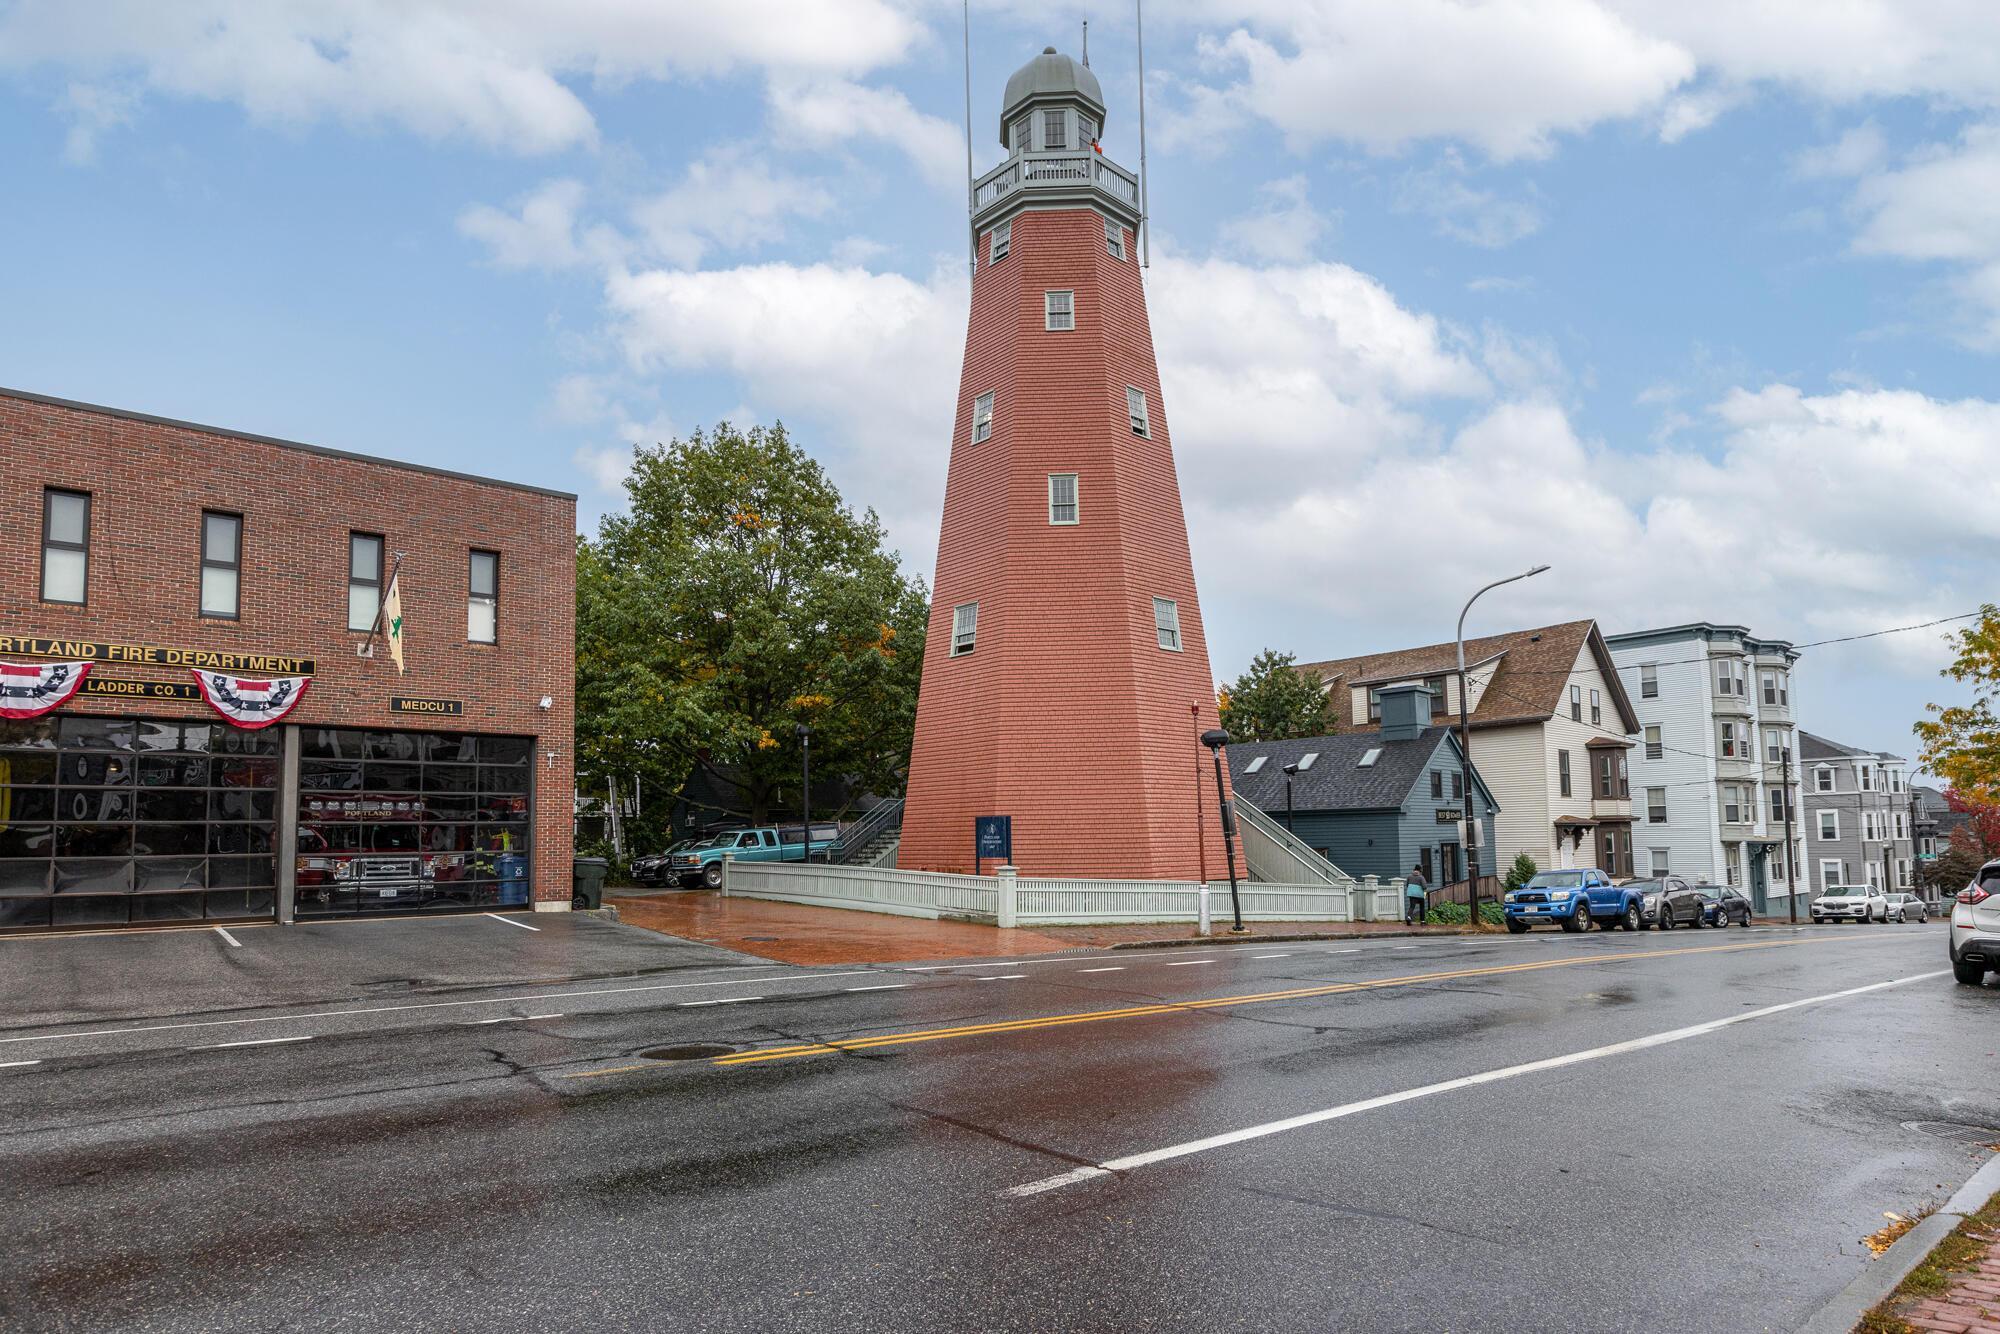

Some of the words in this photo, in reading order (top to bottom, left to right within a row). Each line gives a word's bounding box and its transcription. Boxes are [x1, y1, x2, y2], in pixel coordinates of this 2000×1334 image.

[108, 646, 157, 662] FIRE
[167, 650, 305, 673] DEPARTMENT
[87, 680, 145, 694] LADDER
[154, 684, 177, 696] CO.
[183, 686, 190, 697] 1
[401, 700, 445, 711] MEDCU
[448, 703, 454, 711] 1
